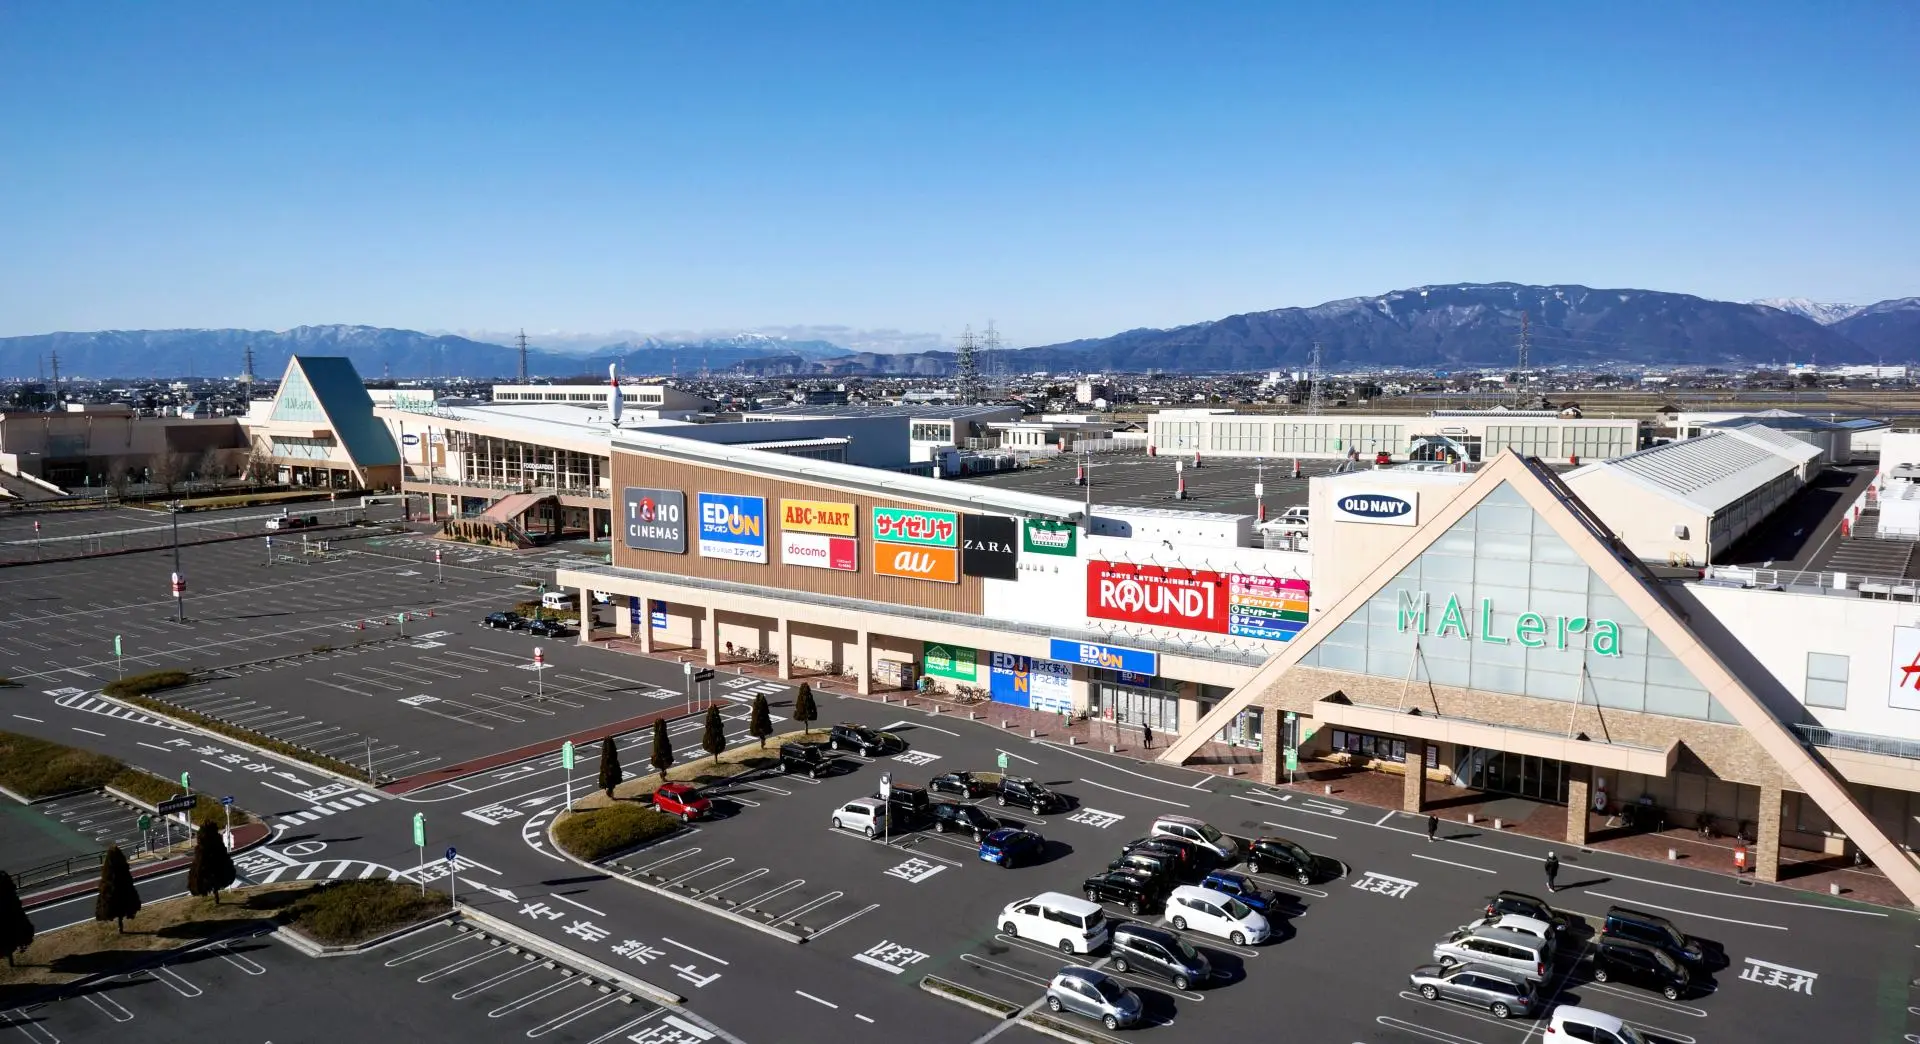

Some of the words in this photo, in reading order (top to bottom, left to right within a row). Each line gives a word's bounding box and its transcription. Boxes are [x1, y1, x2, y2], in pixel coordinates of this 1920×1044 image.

[629, 496, 679, 522] TOHO
[785, 506, 850, 526] ABC-MART
[1344, 499, 1369, 512] OLD
[1370, 500, 1404, 514] NAVY
[703, 503, 760, 536] EDION
[877, 514, 953, 540] サイゼリヤ
[630, 525, 679, 540] CINEMAS
[734, 547, 762, 558] エディオン
[788, 543, 827, 558] docomo
[964, 540, 1013, 553] ZARA
[894, 551, 936, 573] au
[1101, 571, 1131, 580] SPORTS
[1133, 573, 1201, 587] ENTERTAINMENT
[1241, 607, 1282, 617] ビリヤード
[1241, 617, 1265, 626] ダーツ
[1397, 588, 1622, 658] MALera
[1080, 644, 1123, 668] EDION
[1350, 876, 1414, 899] 止まれ
[519, 902, 723, 988] 左折禁止
[1738, 965, 1814, 996] 止まれ
